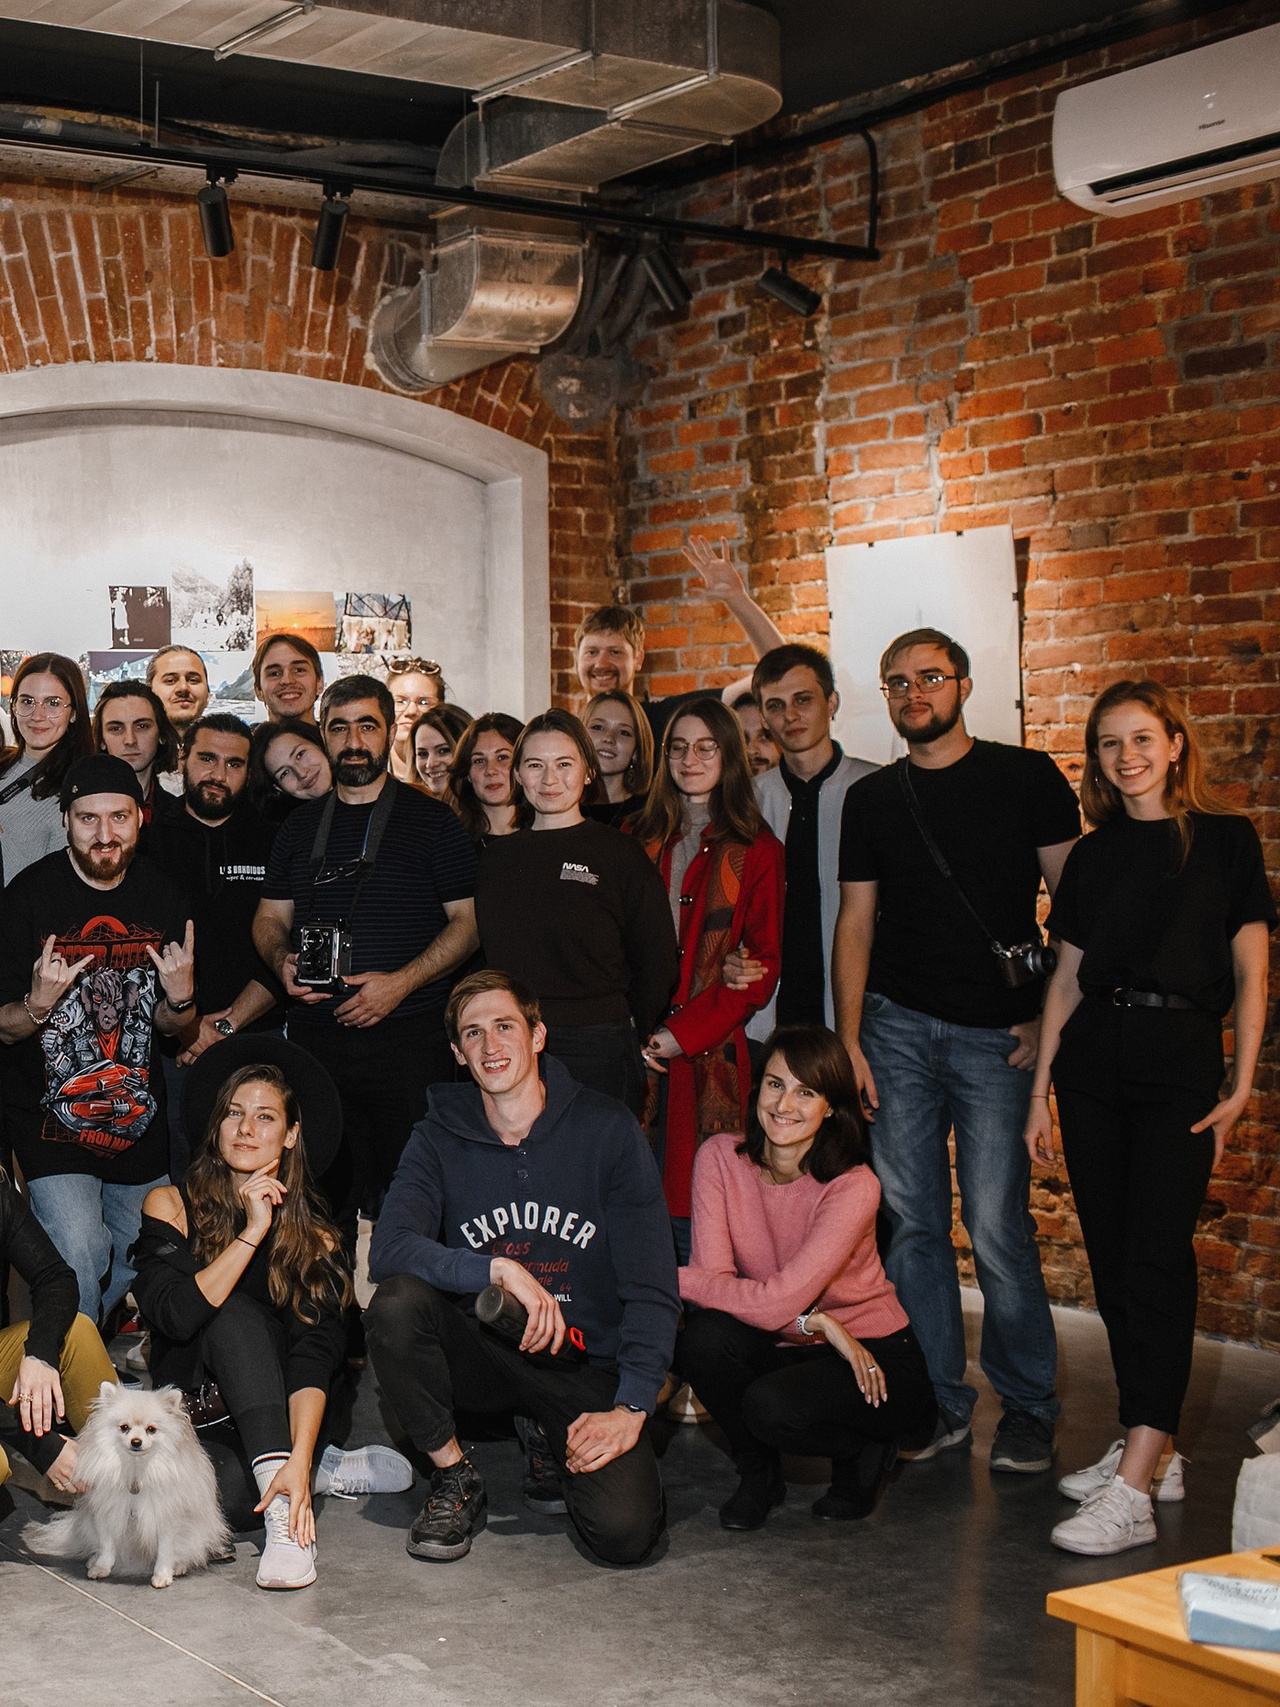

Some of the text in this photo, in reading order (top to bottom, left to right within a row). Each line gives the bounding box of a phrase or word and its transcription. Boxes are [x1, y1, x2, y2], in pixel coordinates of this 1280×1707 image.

[562, 862, 589, 873] NASA
[80, 1129, 112, 1147] FROM
[460, 1201, 596, 1250] EXPLORER
[514, 1258, 569, 1274] ermuda
[560, 1284, 572, 1292] 64
[554, 1294, 572, 1302] WILL
